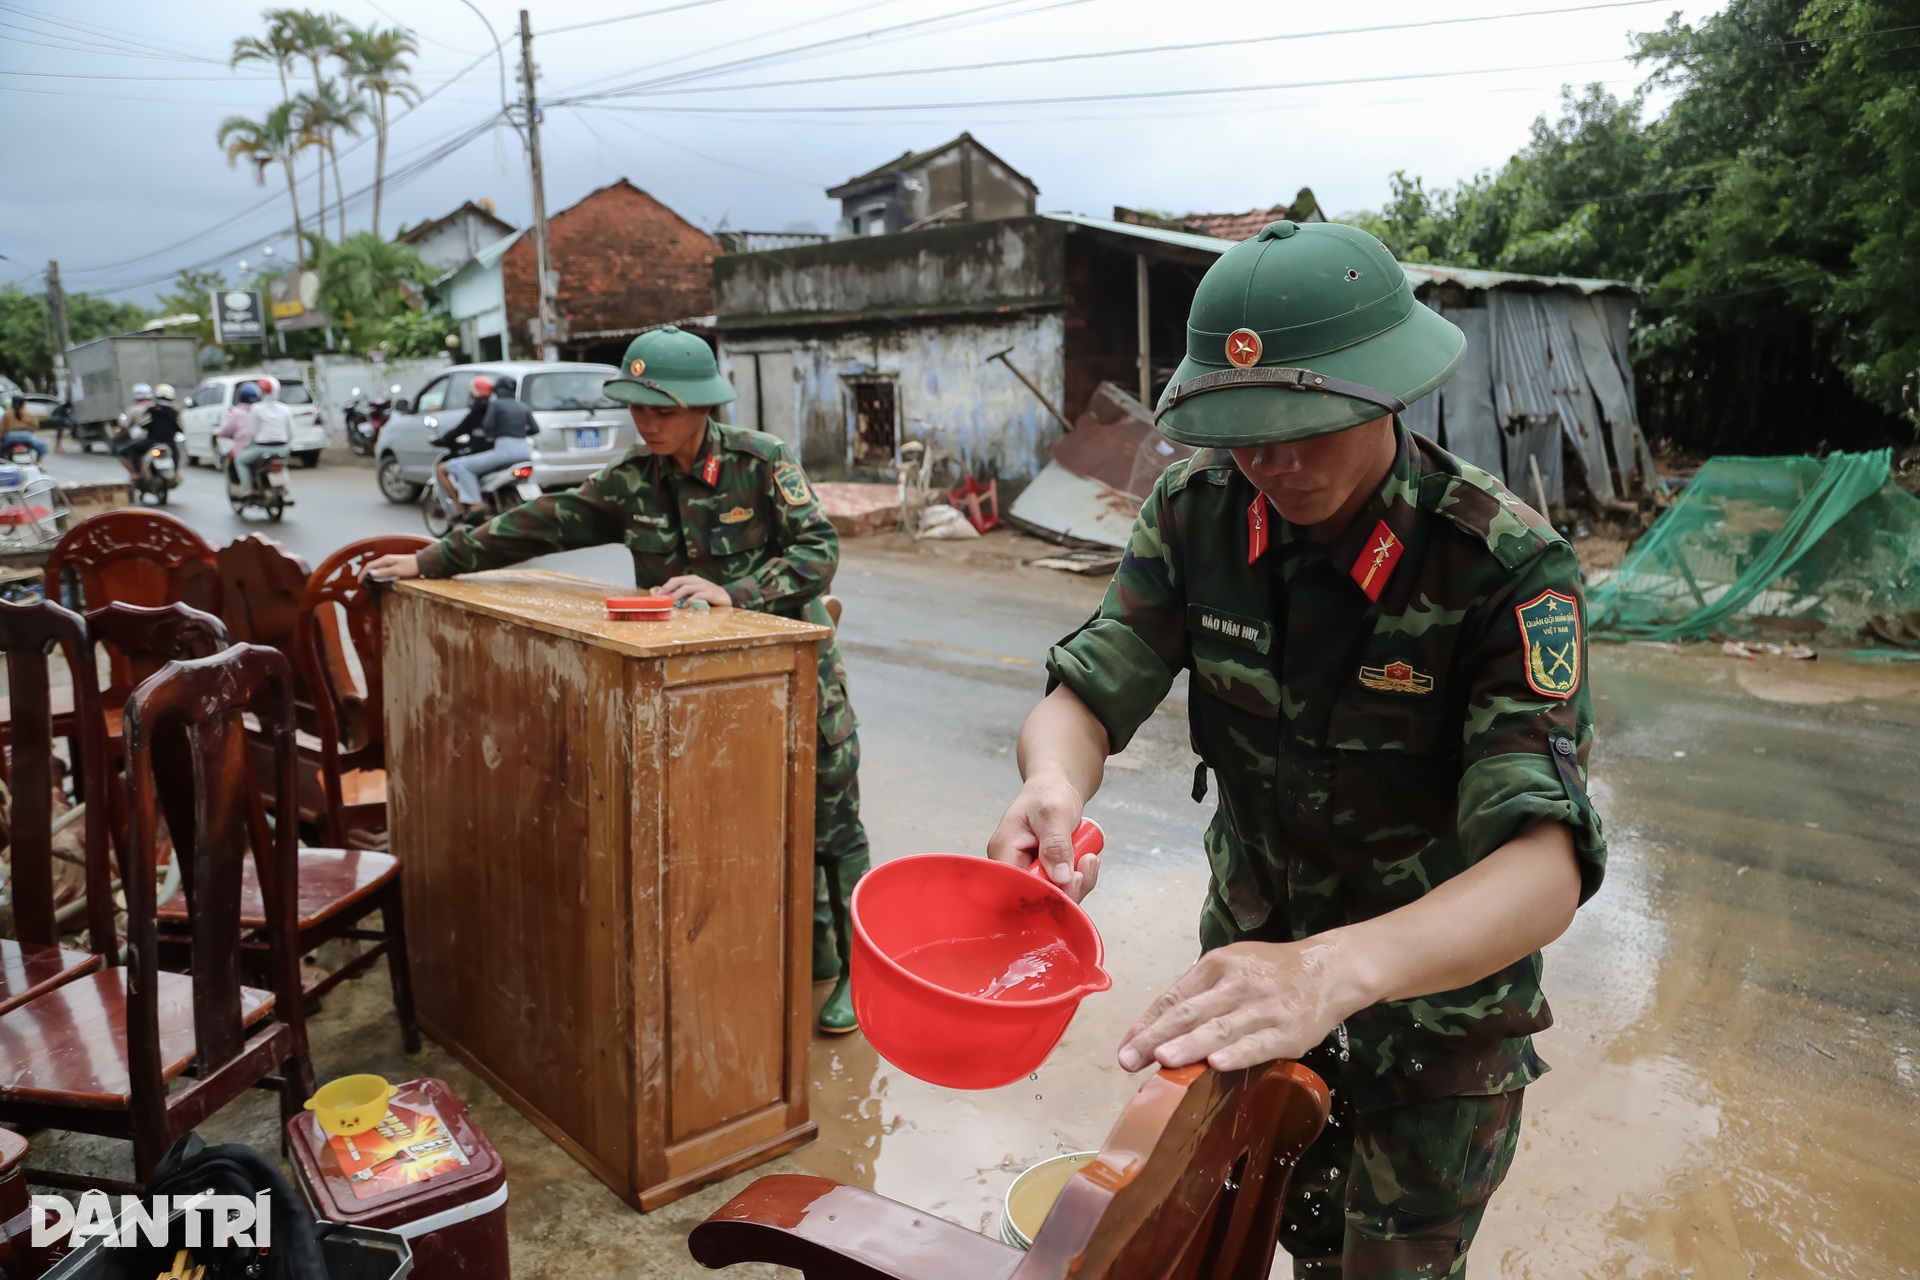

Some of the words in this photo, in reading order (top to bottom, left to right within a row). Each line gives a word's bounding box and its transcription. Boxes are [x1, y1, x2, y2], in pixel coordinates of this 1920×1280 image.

[1526, 617, 1544, 628] QUÂN
[1221, 619, 1240, 637] VĂN
[1241, 625, 1259, 642] HUY
[1542, 626, 1557, 635] VIỆT
